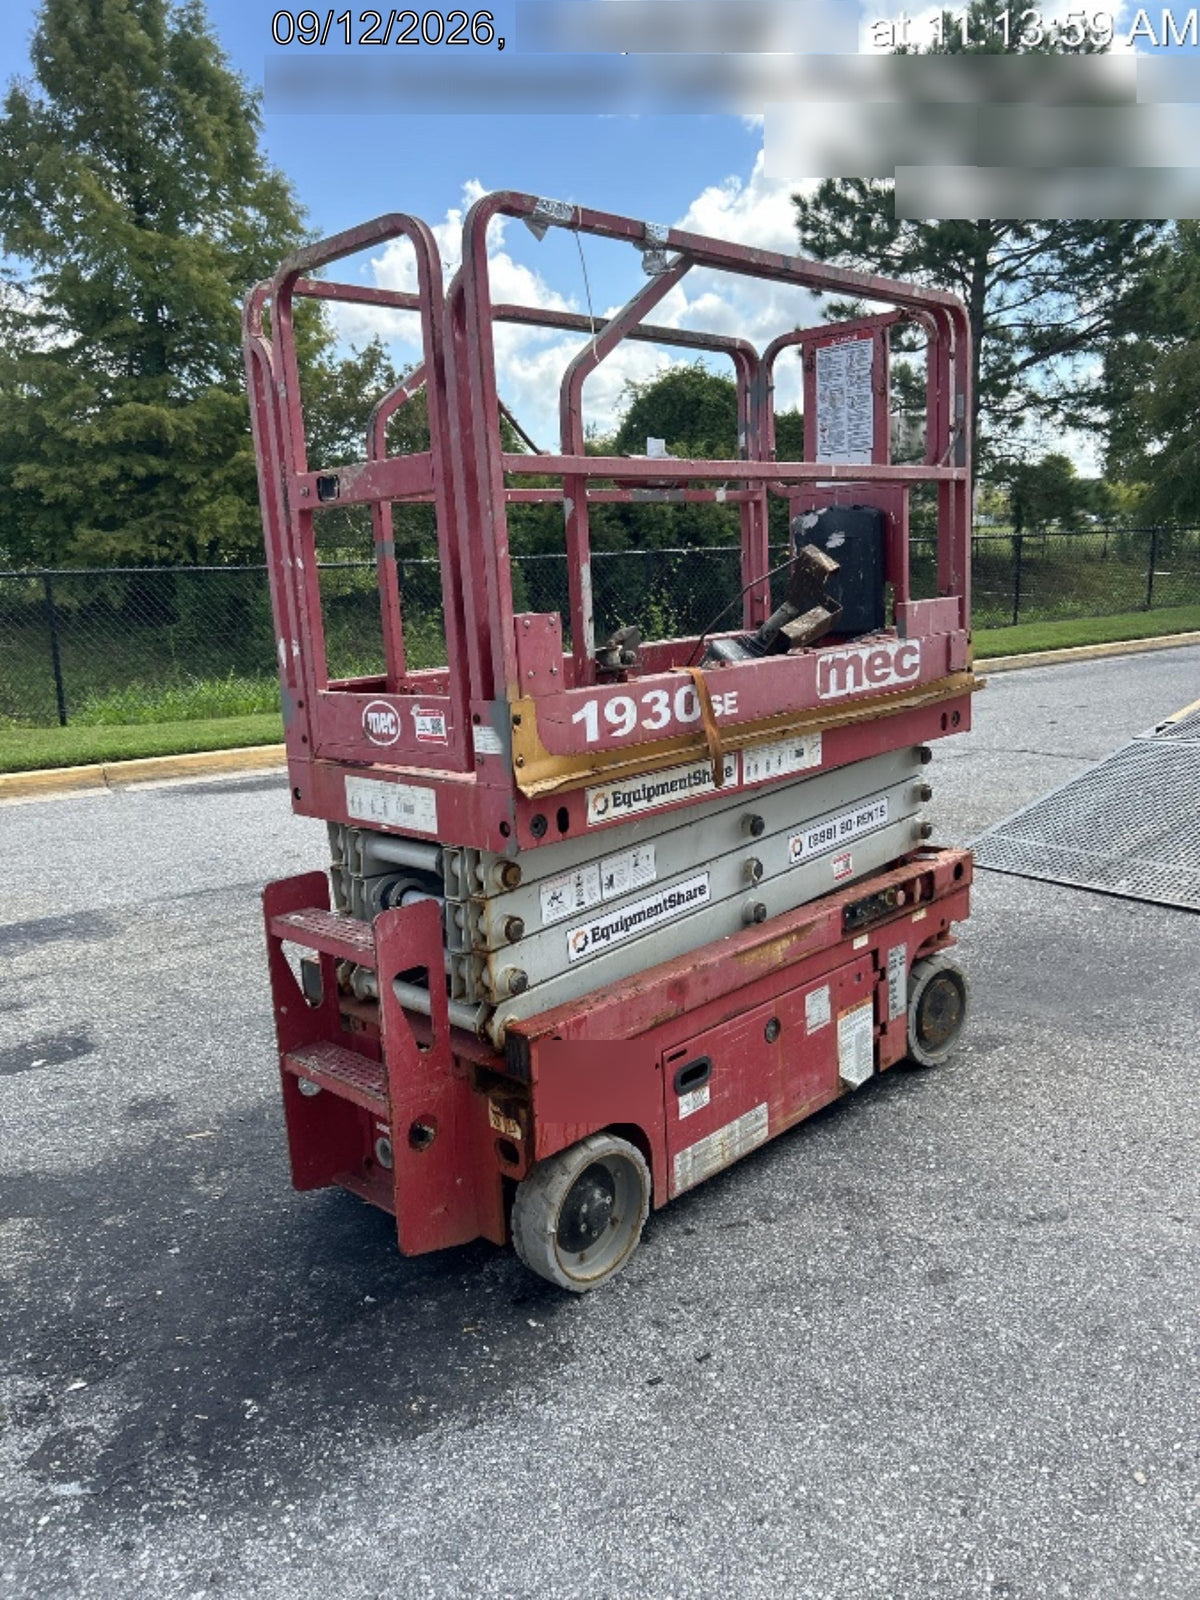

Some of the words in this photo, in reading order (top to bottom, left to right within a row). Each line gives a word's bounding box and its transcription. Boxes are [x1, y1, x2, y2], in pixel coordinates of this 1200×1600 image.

[818, 643, 920, 698] mec
[571, 684, 701, 743] 1930
[710, 690, 739, 718] SE
[611, 765, 734, 808] EquipmentShe
[590, 883, 707, 944] EquipmentShare
